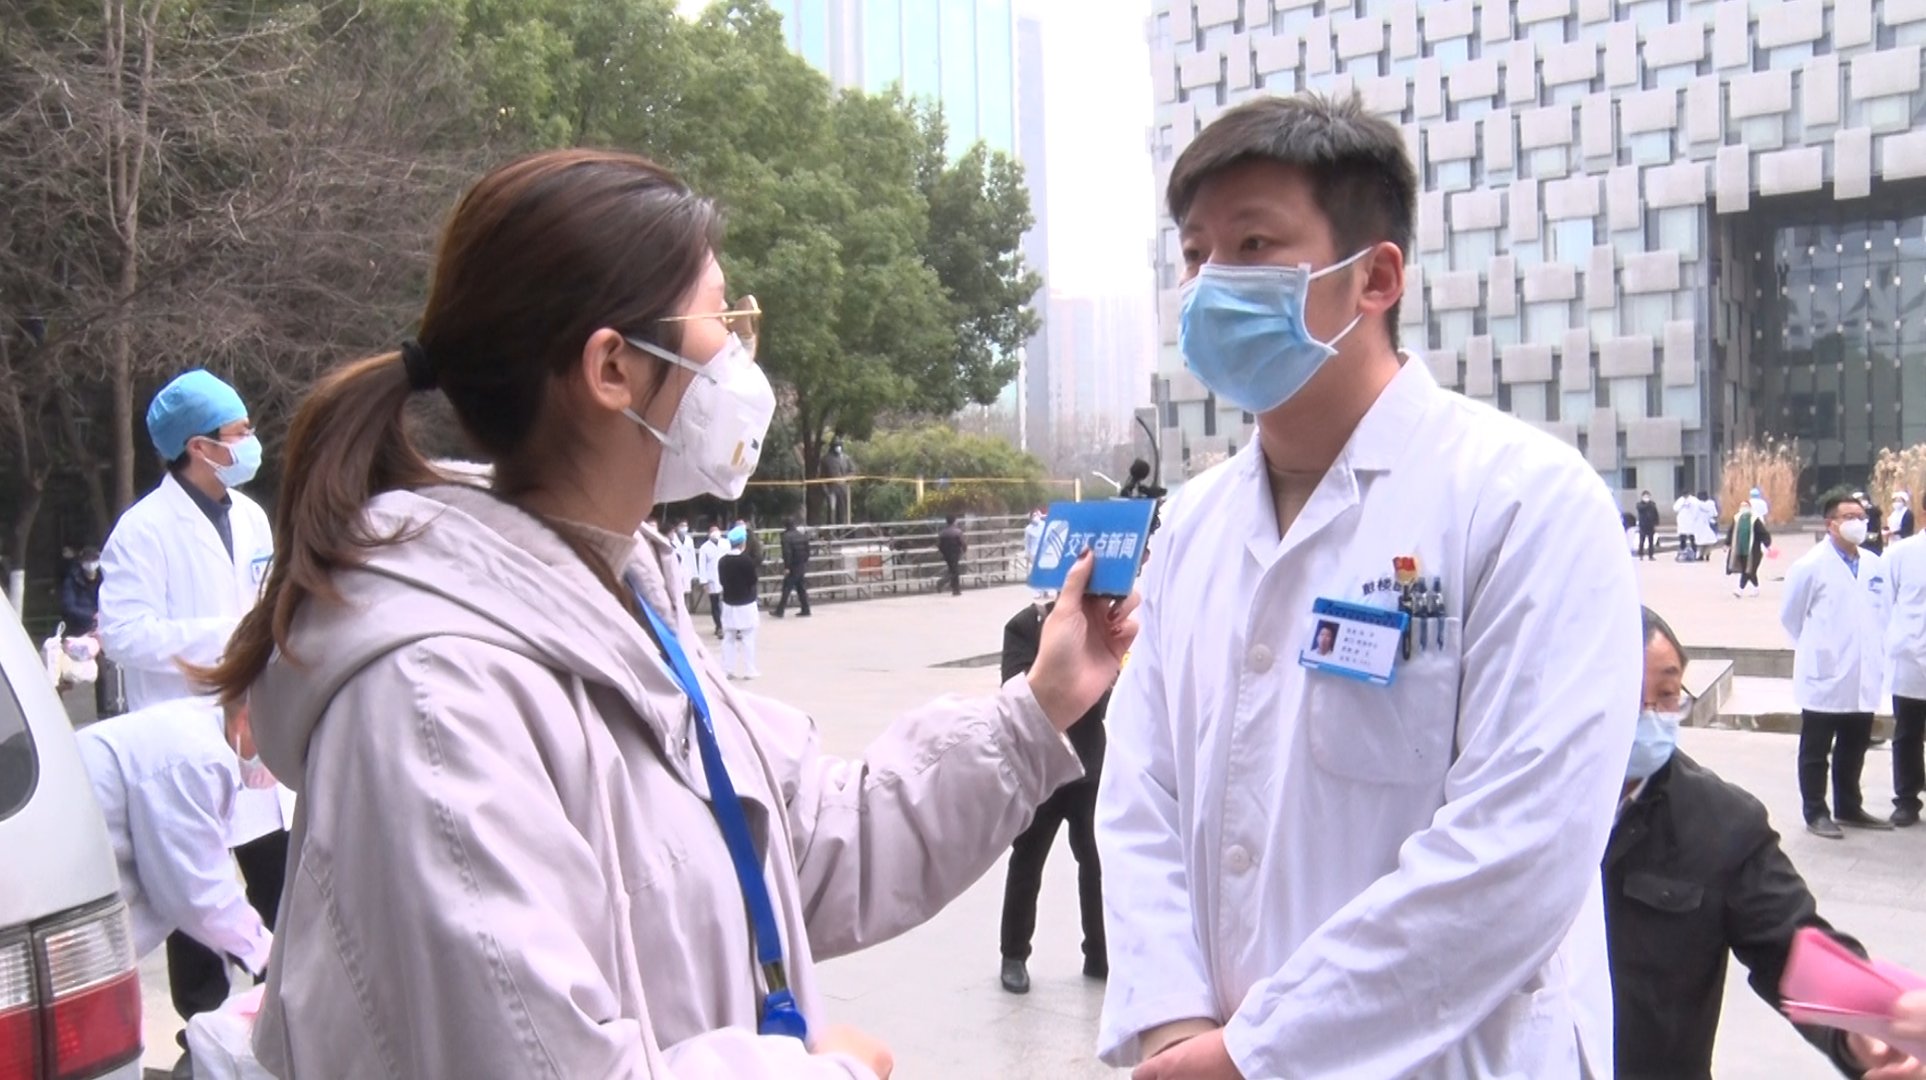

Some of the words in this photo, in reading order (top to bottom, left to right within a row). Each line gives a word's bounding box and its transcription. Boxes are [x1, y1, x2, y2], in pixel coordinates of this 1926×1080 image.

[1064, 531, 1139, 559] 交汇点新闻
